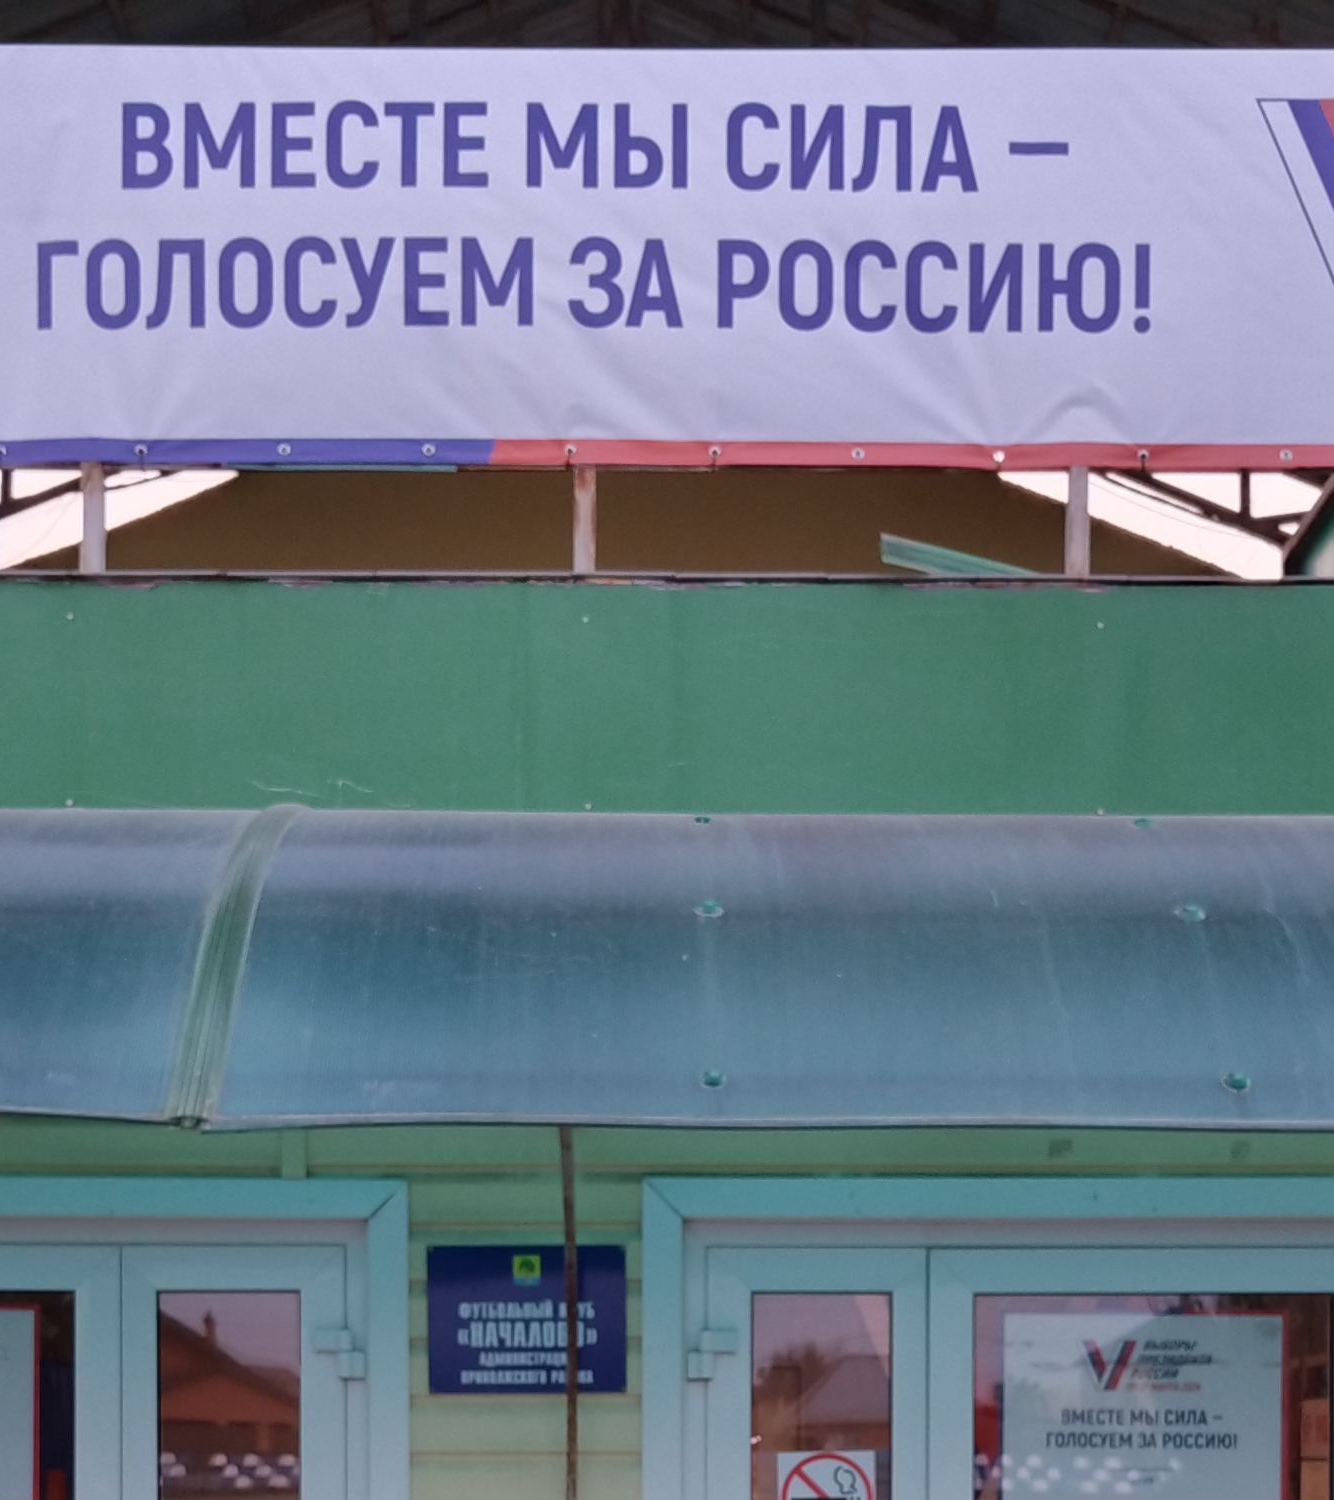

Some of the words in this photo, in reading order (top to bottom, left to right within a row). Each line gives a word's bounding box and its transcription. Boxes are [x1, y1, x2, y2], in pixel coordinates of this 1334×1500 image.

[121, 102, 488, 190] ВМЕСТЕ
[524, 102, 689, 190] МЫ
[725, 103, 980, 193] СИЛА
[35, 236, 535, 330] ГОЛОСУЕМ
[566, 238, 683, 328] ЗА
[717, 243, 1154, 332] РОССИЮ!
[1046, 1432, 1133, 1449] ГОЛОСУЕМ
[1139, 1432, 1157, 1449] ЗА
[1162, 1433, 1238, 1450] РОССИЮ!
[1061, 1408, 1124, 1426] ВМЕСТЕ
[1129, 1409, 1159, 1426] МЫ
[1164, 1409, 1207, 1426] СИЛА
